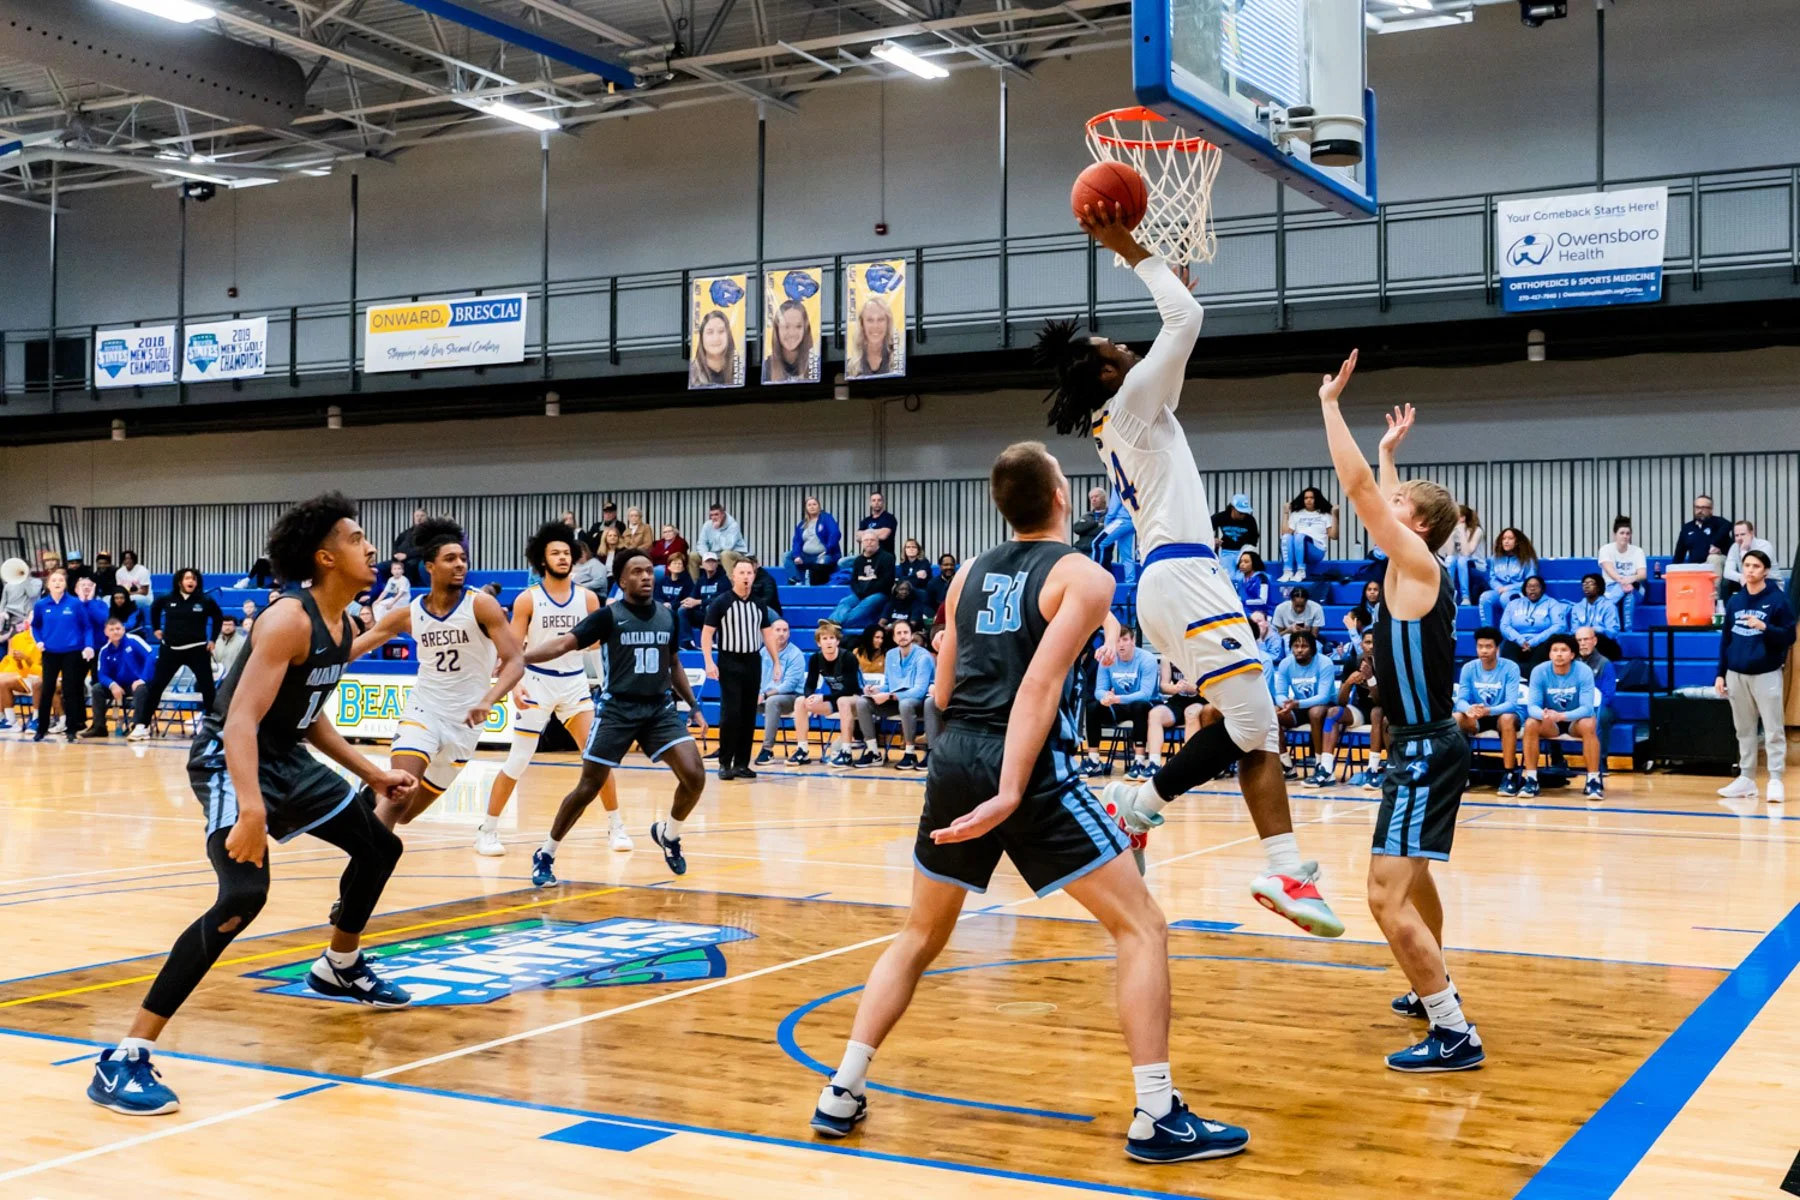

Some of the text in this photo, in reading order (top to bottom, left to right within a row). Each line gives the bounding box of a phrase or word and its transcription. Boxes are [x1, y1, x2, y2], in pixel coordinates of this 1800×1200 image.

[1507, 200, 1659, 223] Your Comeback Starts Here!
[1557, 228, 1659, 247] Owensboro
[1559, 248, 1604, 262] Health
[1509, 272, 1656, 291] ORTHOPEDICS & SPORTS MEDICINE
[372, 302, 519, 328] ONWARD, BRESCIA!
[138, 336, 165, 349] 2018
[232, 327, 251, 343] 2019
[154, 346, 172, 360] GOLF
[244, 340, 264, 352] GOLF
[387, 339, 500, 360] Stepping into Our Second Century
[130, 359, 171, 375] CHAMPIONS
[220, 351, 263, 371] CHAMPIONS
[976, 571, 1029, 635] 33
[421, 629, 470, 648] BRESCIA
[620, 631, 671, 645] OAKLAND CITY
[435, 649, 461, 672] 22
[634, 647, 659, 673] 10
